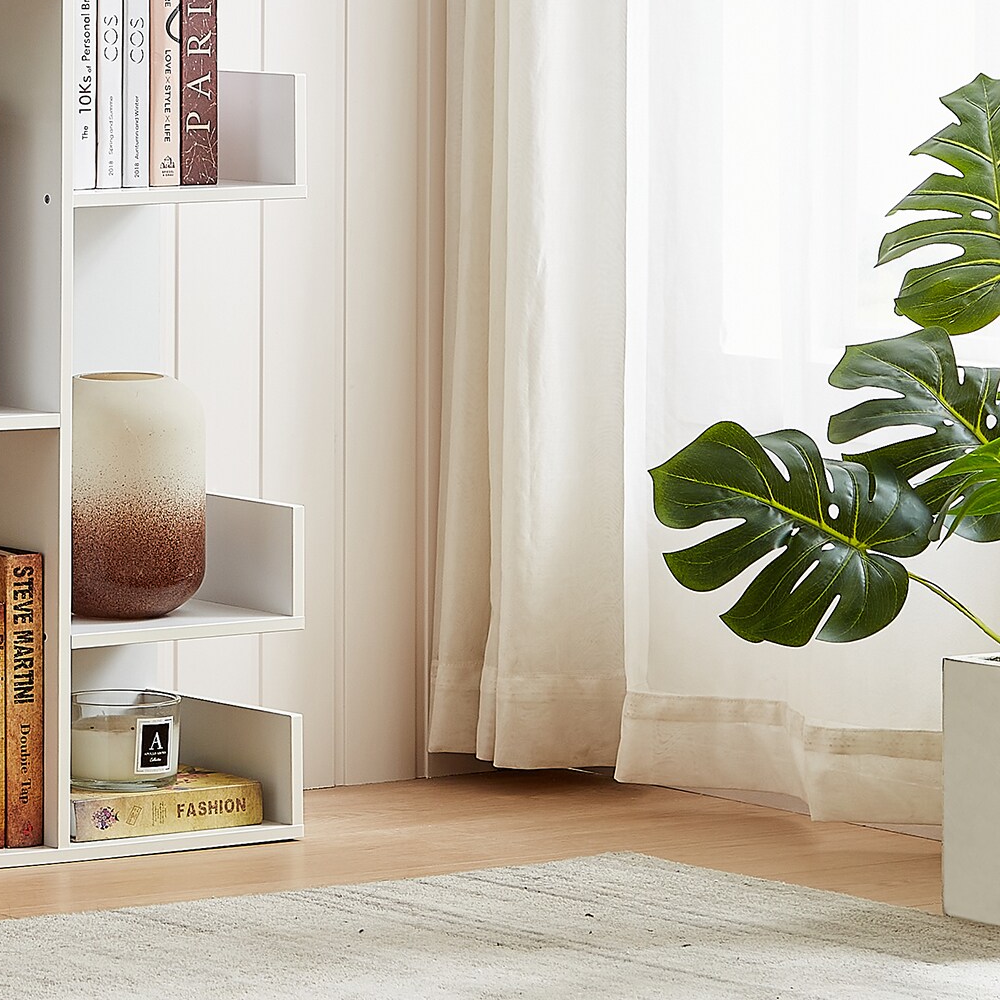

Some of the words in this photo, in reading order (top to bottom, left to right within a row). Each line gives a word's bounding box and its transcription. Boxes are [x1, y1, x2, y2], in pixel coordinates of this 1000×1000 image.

[80, 13, 91, 61] Personal
[103, 14, 119, 62] COS
[129, 16, 145, 64] COS
[164, 49, 172, 75] LOVE
[79, 75, 92, 114] 10Ks
[164, 85, 172, 113] STYLE
[81, 125, 89, 140] The
[163, 123, 171, 143] LIFE
[13, 566, 33, 625] STEVE
[14, 630, 34, 705] MARTINI
[149, 731, 163, 751] A
[18, 778, 31, 805] Tap
[176, 798, 246, 818] FASHION
